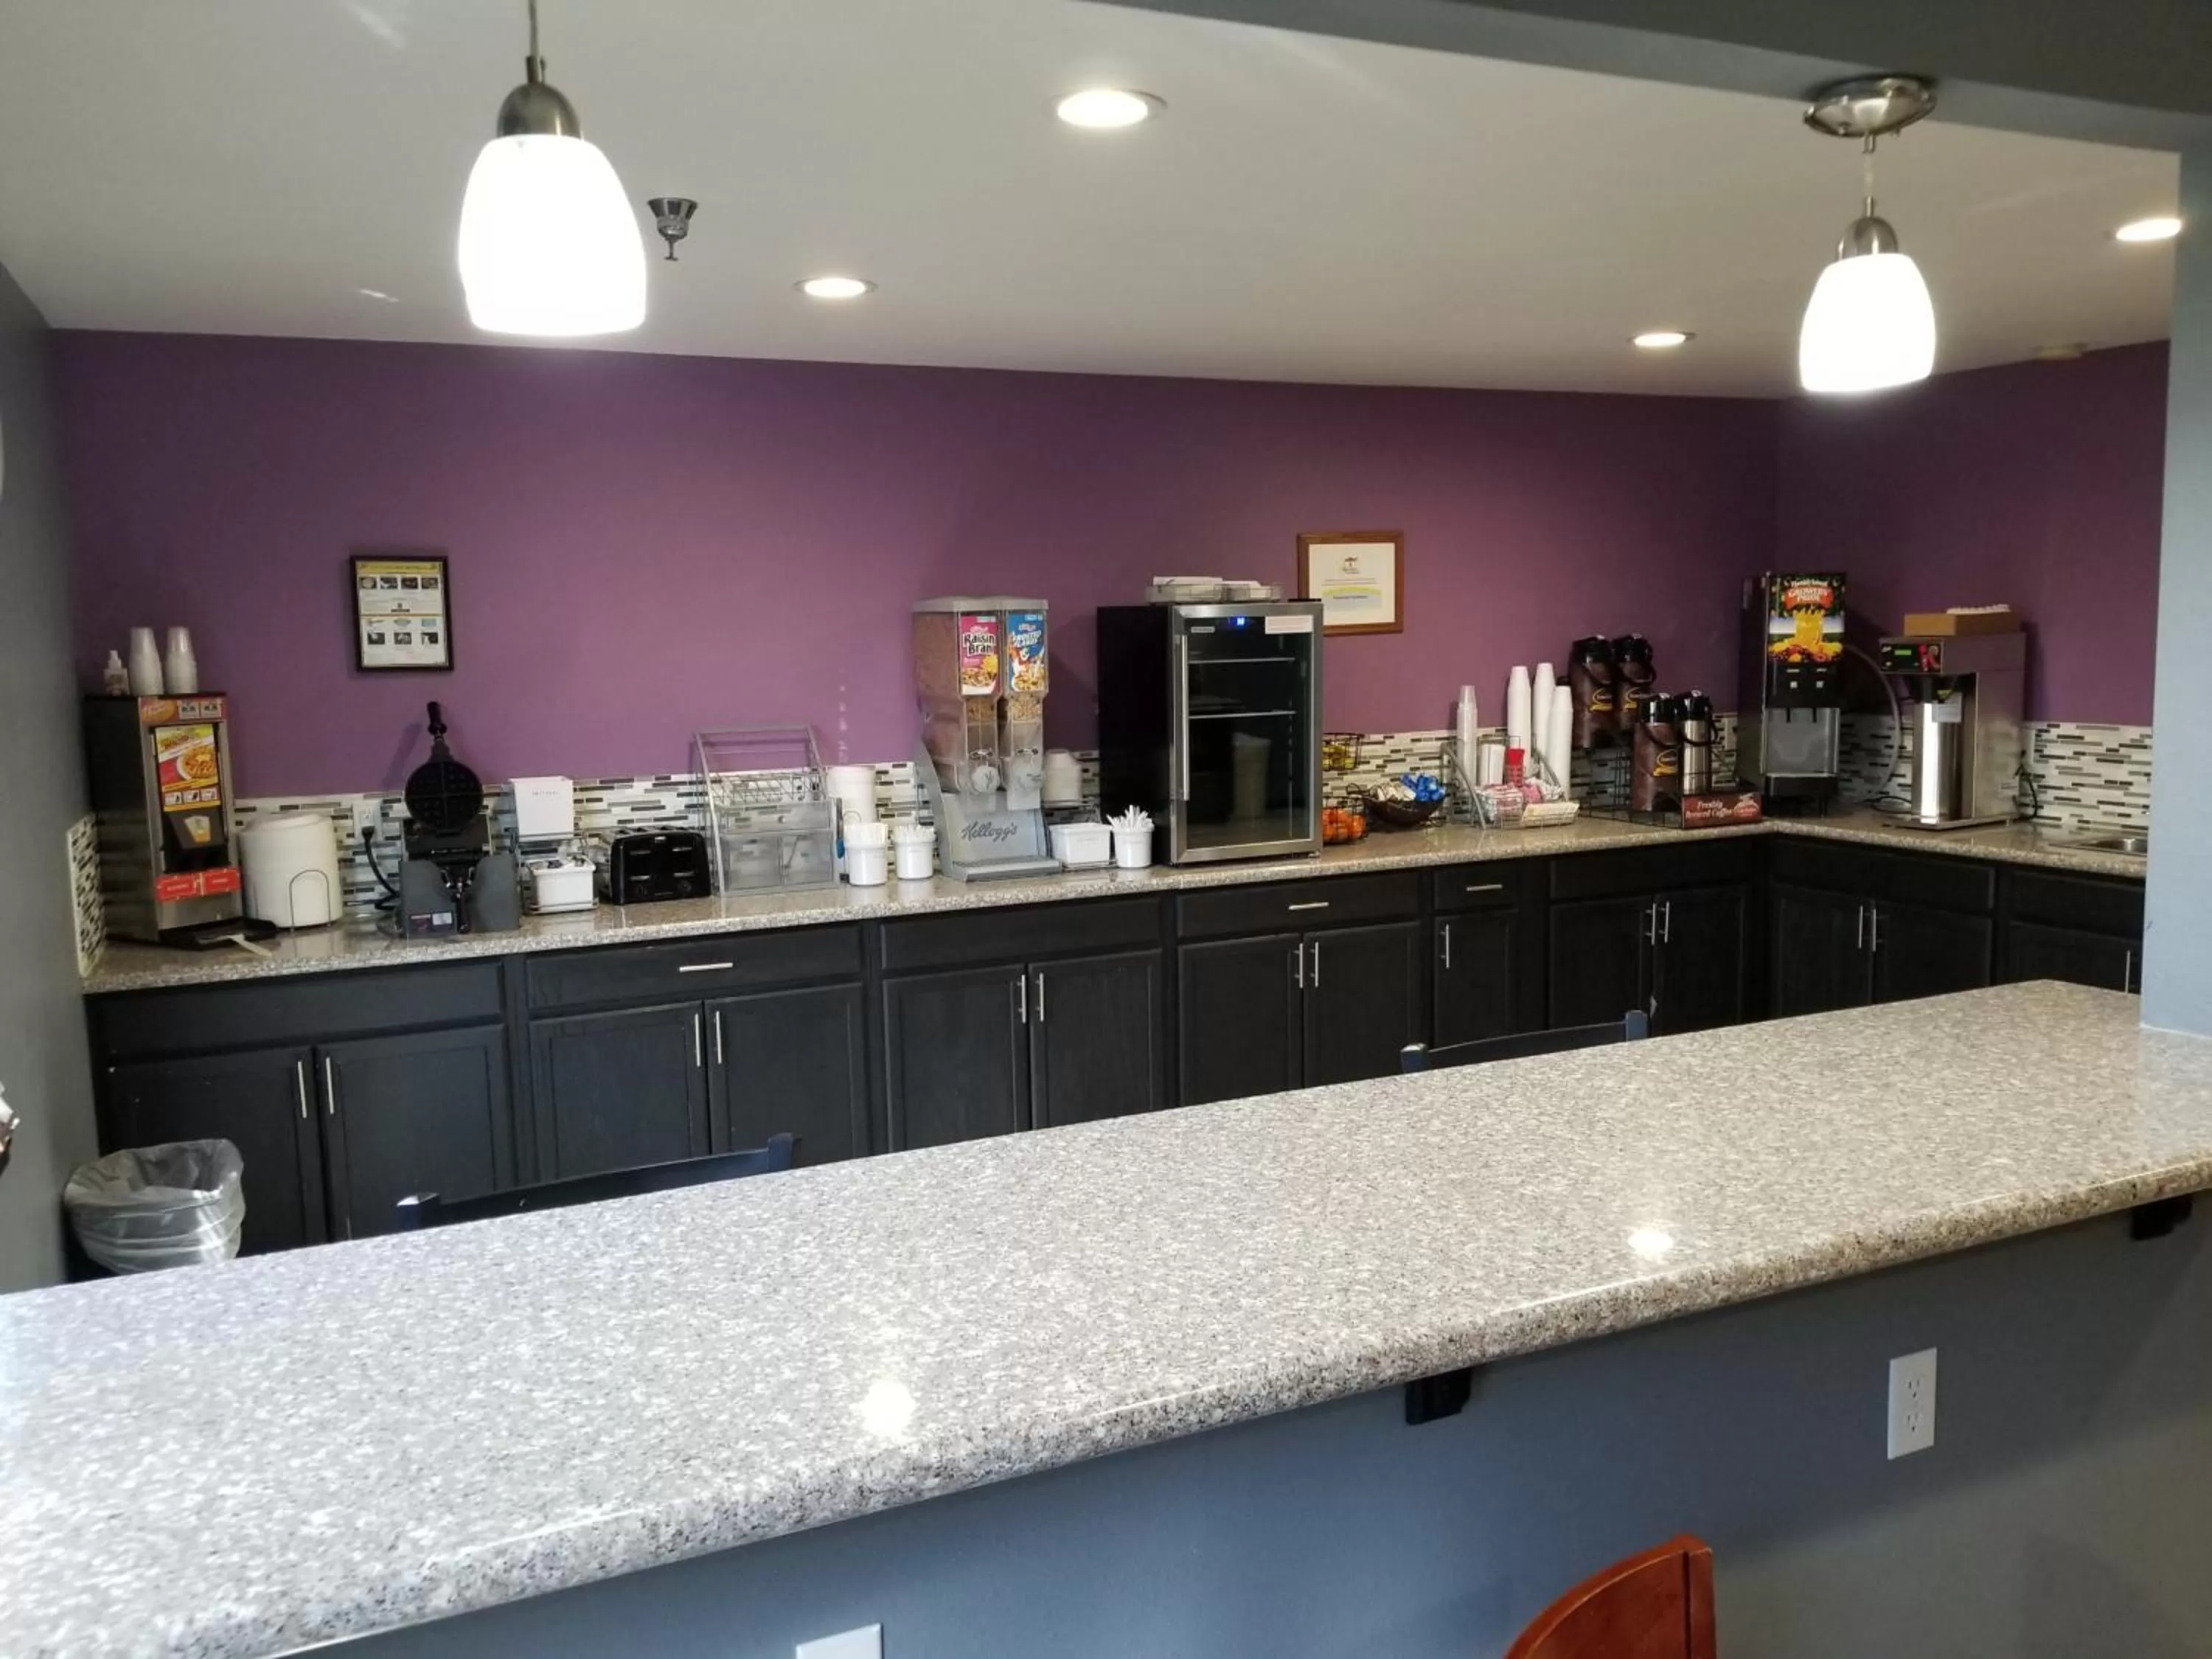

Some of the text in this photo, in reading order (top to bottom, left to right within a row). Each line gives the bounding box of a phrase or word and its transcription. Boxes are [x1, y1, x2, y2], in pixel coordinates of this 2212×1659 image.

[964, 633, 995, 645] Raisin
[968, 643, 992, 655] Bran
[961, 820, 1018, 843] Kellogg's
